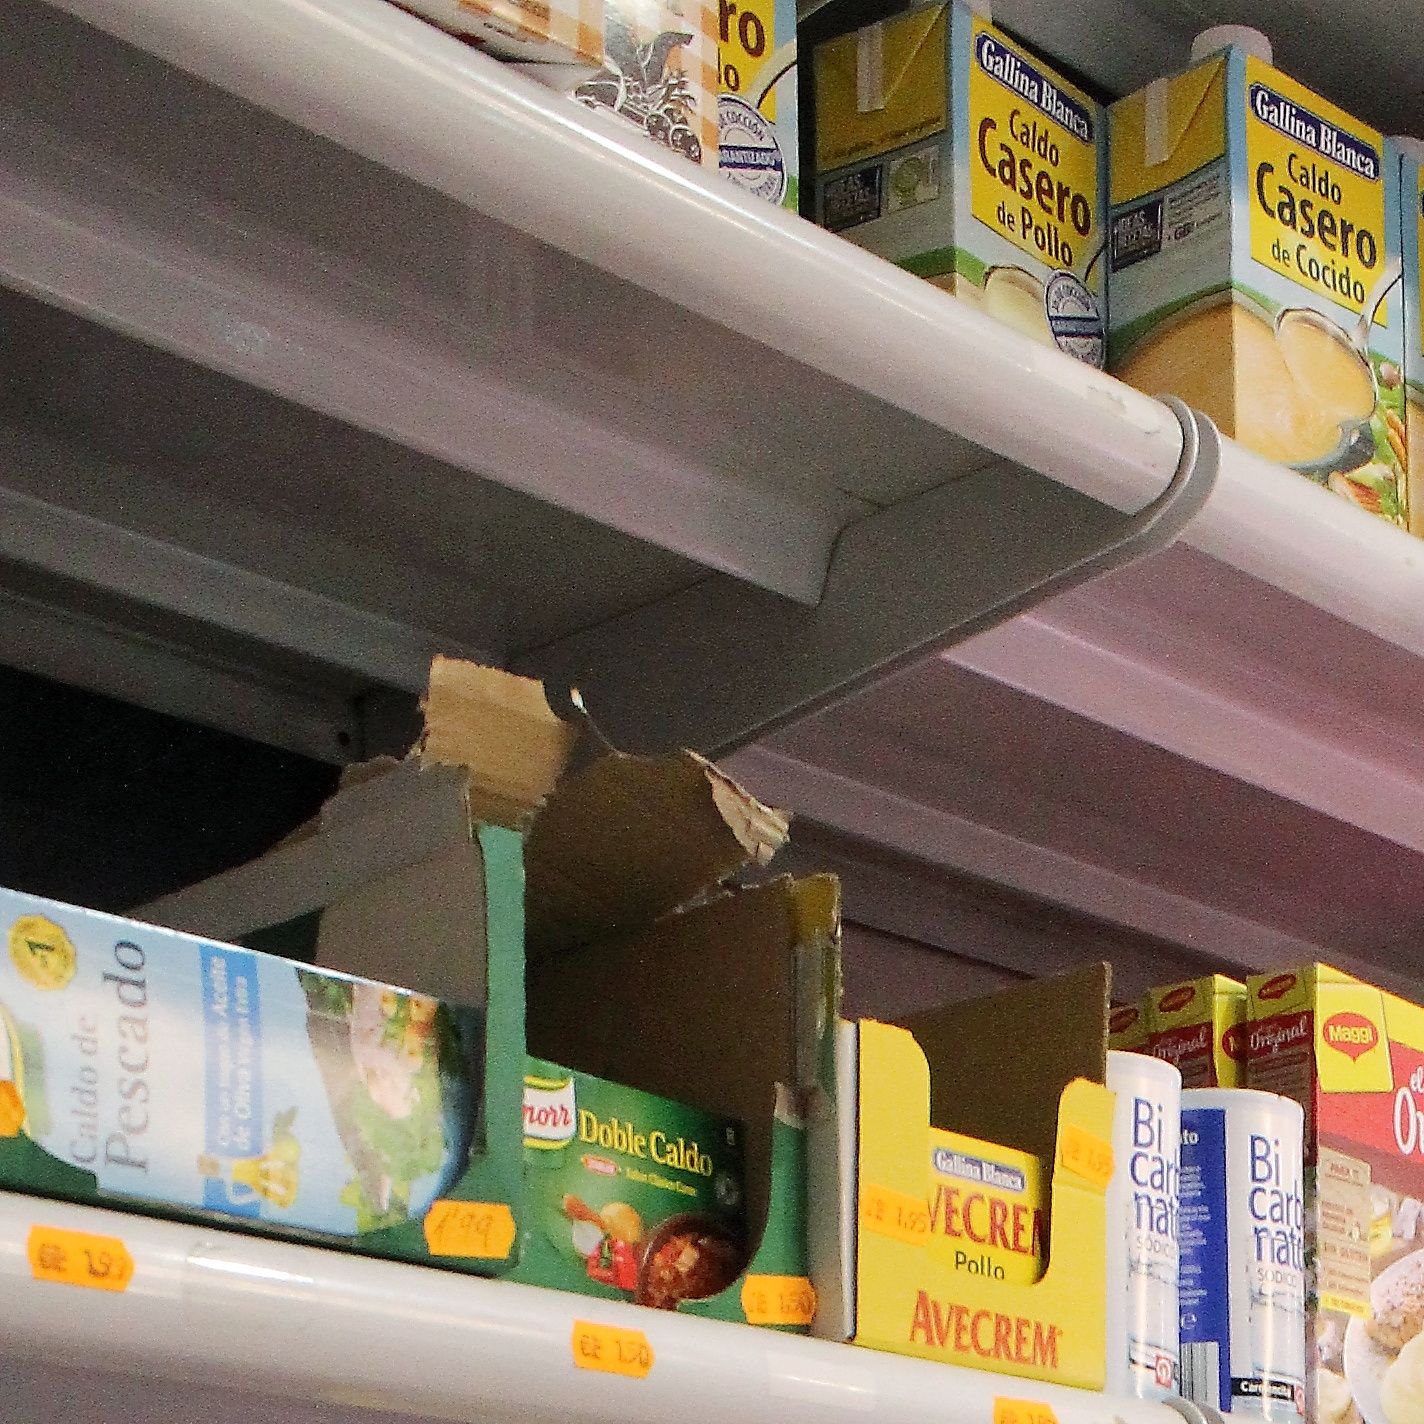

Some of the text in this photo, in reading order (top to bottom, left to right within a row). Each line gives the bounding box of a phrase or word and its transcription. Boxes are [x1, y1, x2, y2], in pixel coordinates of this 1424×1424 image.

[978, 37, 1091, 142] Gallina Blanca
[1008, 110, 1060, 167] Caldo
[1254, 91, 1377, 179] Gallina Blanca
[978, 118, 1091, 236] Casero
[1288, 153, 1342, 205] Caldo
[996, 201, 1073, 268] de Pollo
[1256, 162, 1377, 268] Casero
[1271, 236, 1366, 304] de Cocido
[103, 938, 148, 1175] Pescado
[1328, 1023, 1372, 1045] Maggi
[69, 1012, 98, 1164] Caldo de
[1410, 1073, 1424, 1095] el
[579, 1109, 714, 1178] Doble Caldo
[1133, 1096, 1162, 1148] Bi
[935, 1149, 1025, 1191] Gallina Blanca
[1250, 1132, 1280, 1182] Bi
[954, 1252, 1005, 1279] Pollo
[910, 1289, 1059, 1369] AVECREM
